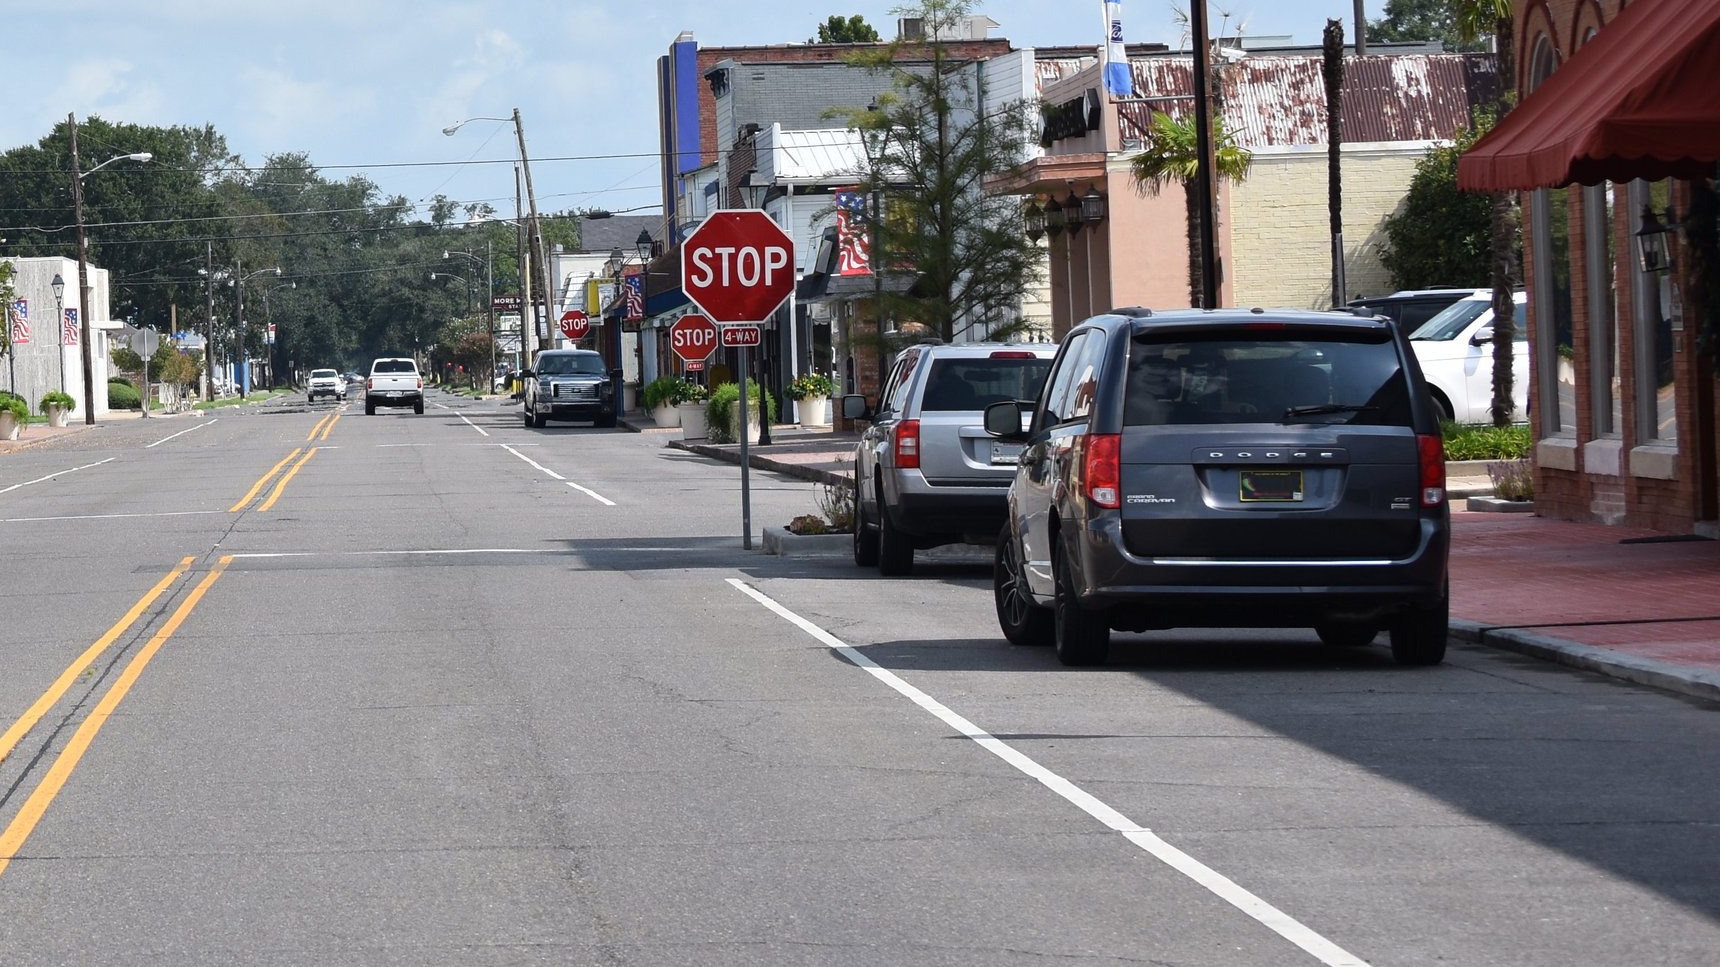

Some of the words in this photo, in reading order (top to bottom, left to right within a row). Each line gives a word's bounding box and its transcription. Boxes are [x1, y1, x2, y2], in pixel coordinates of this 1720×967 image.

[691, 246, 788, 288] STOP
[562, 318, 587, 331] STOP
[674, 328, 714, 347] STOP
[725, 331, 757, 343] 4-WAY
